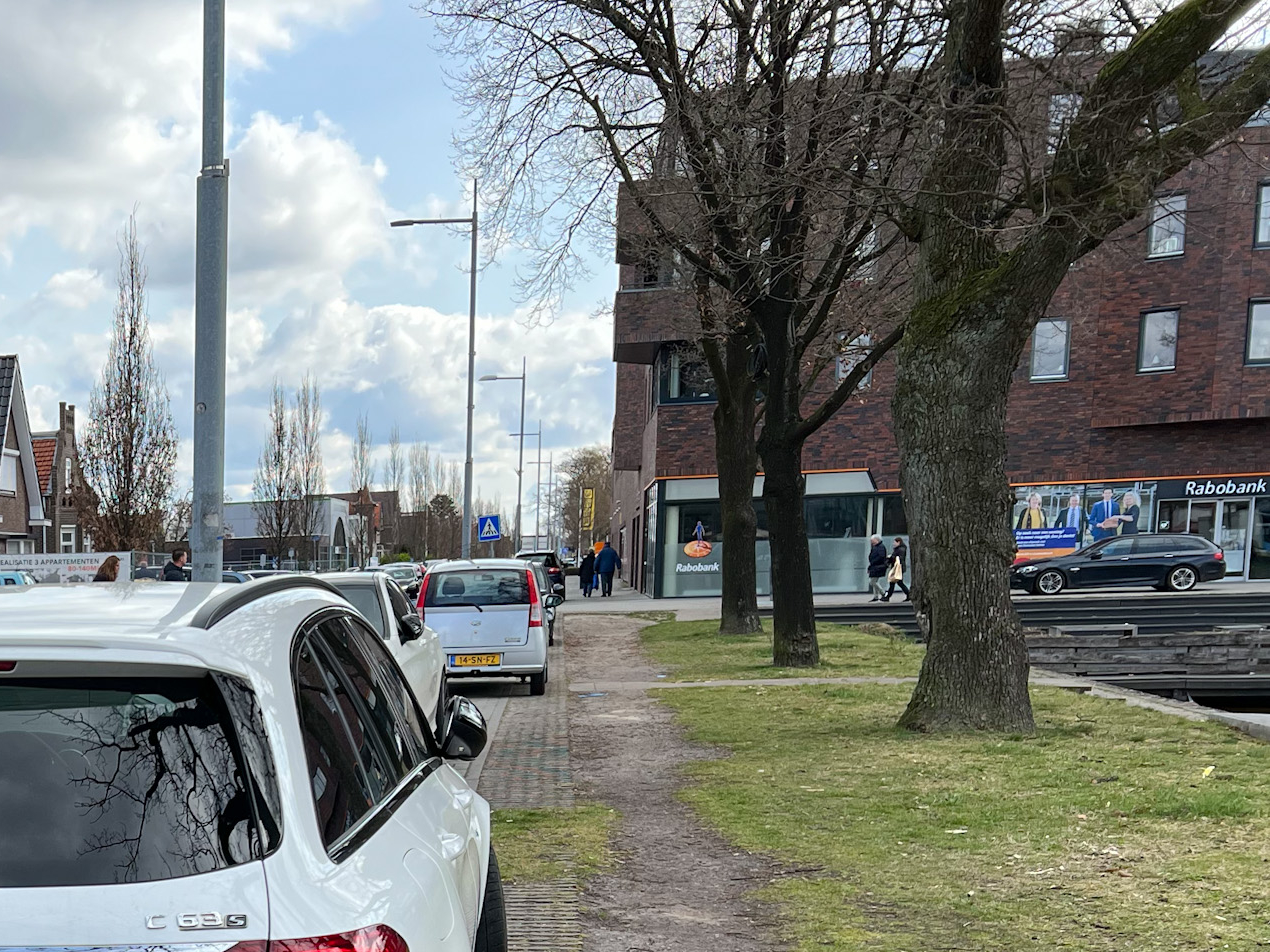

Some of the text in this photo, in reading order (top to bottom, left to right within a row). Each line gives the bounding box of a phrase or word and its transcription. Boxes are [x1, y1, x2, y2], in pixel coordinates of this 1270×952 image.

[1185, 478, 1267, 495] Rabobank
[675, 562, 720, 573] Rabobank
[459, 655, 496, 664] 14-SN-FZ
[145, 914, 167, 930] C
